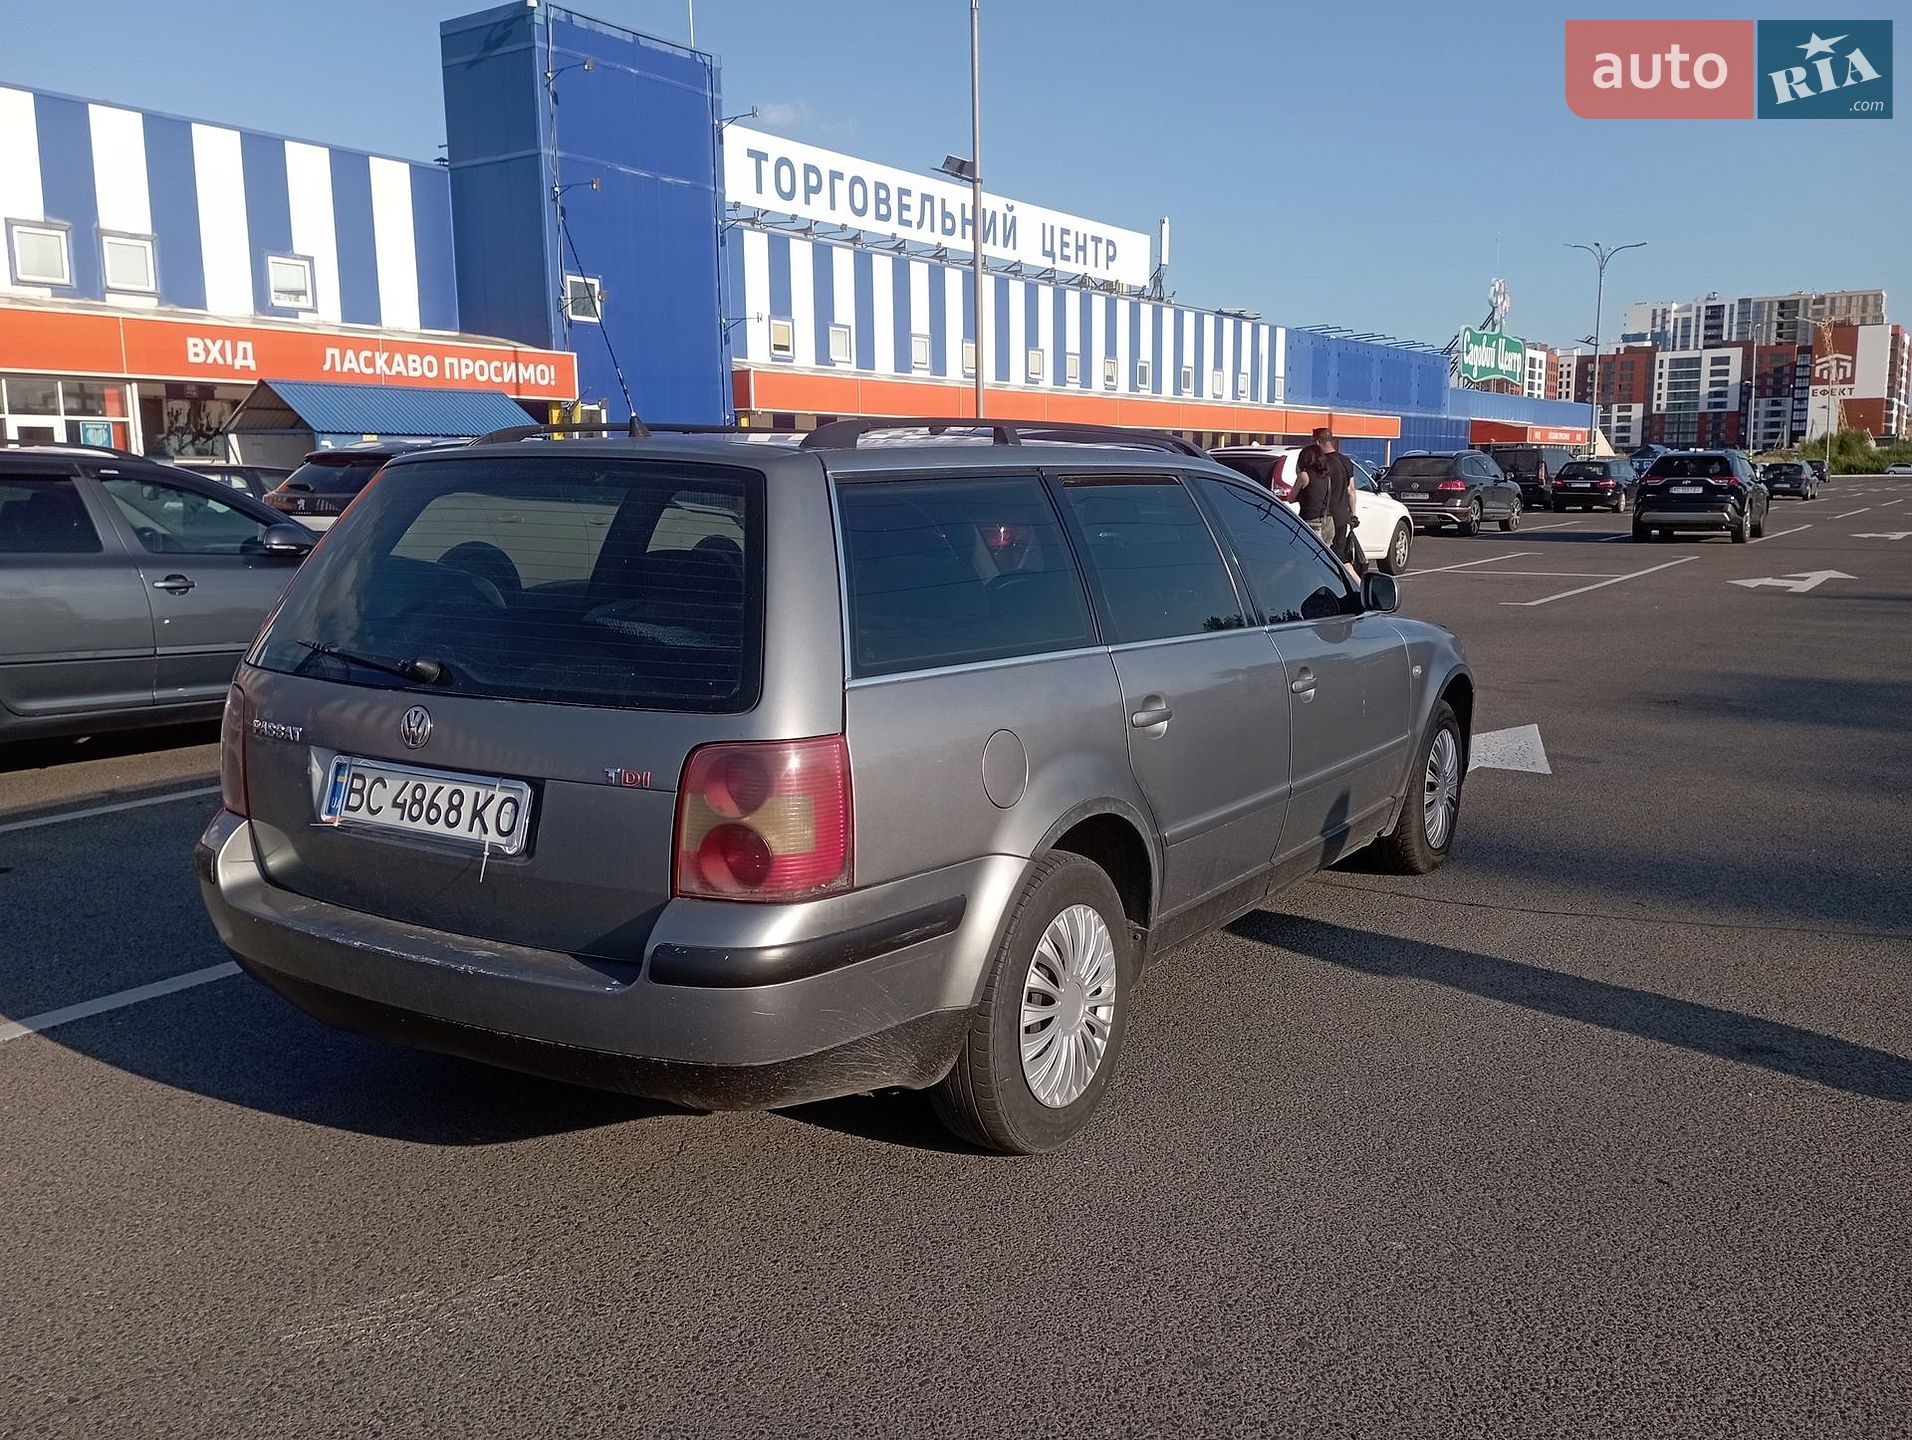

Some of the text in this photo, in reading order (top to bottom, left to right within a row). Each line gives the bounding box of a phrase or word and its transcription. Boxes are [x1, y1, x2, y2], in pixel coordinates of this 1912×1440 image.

[746, 148, 1117, 271] ТОРГОВЕЛЬНИЙ ЦЕНТР
[186, 336, 256, 371] ВХІД
[322, 347, 556, 386] ЛАСКАВО ПРОСИМО!
[1497, 337, 1521, 382] Центр
[252, 719, 303, 742] PASSAT
[604, 767, 651, 788] TDI
[345, 773, 387, 815] BC
[391, 780, 465, 829] 4868
